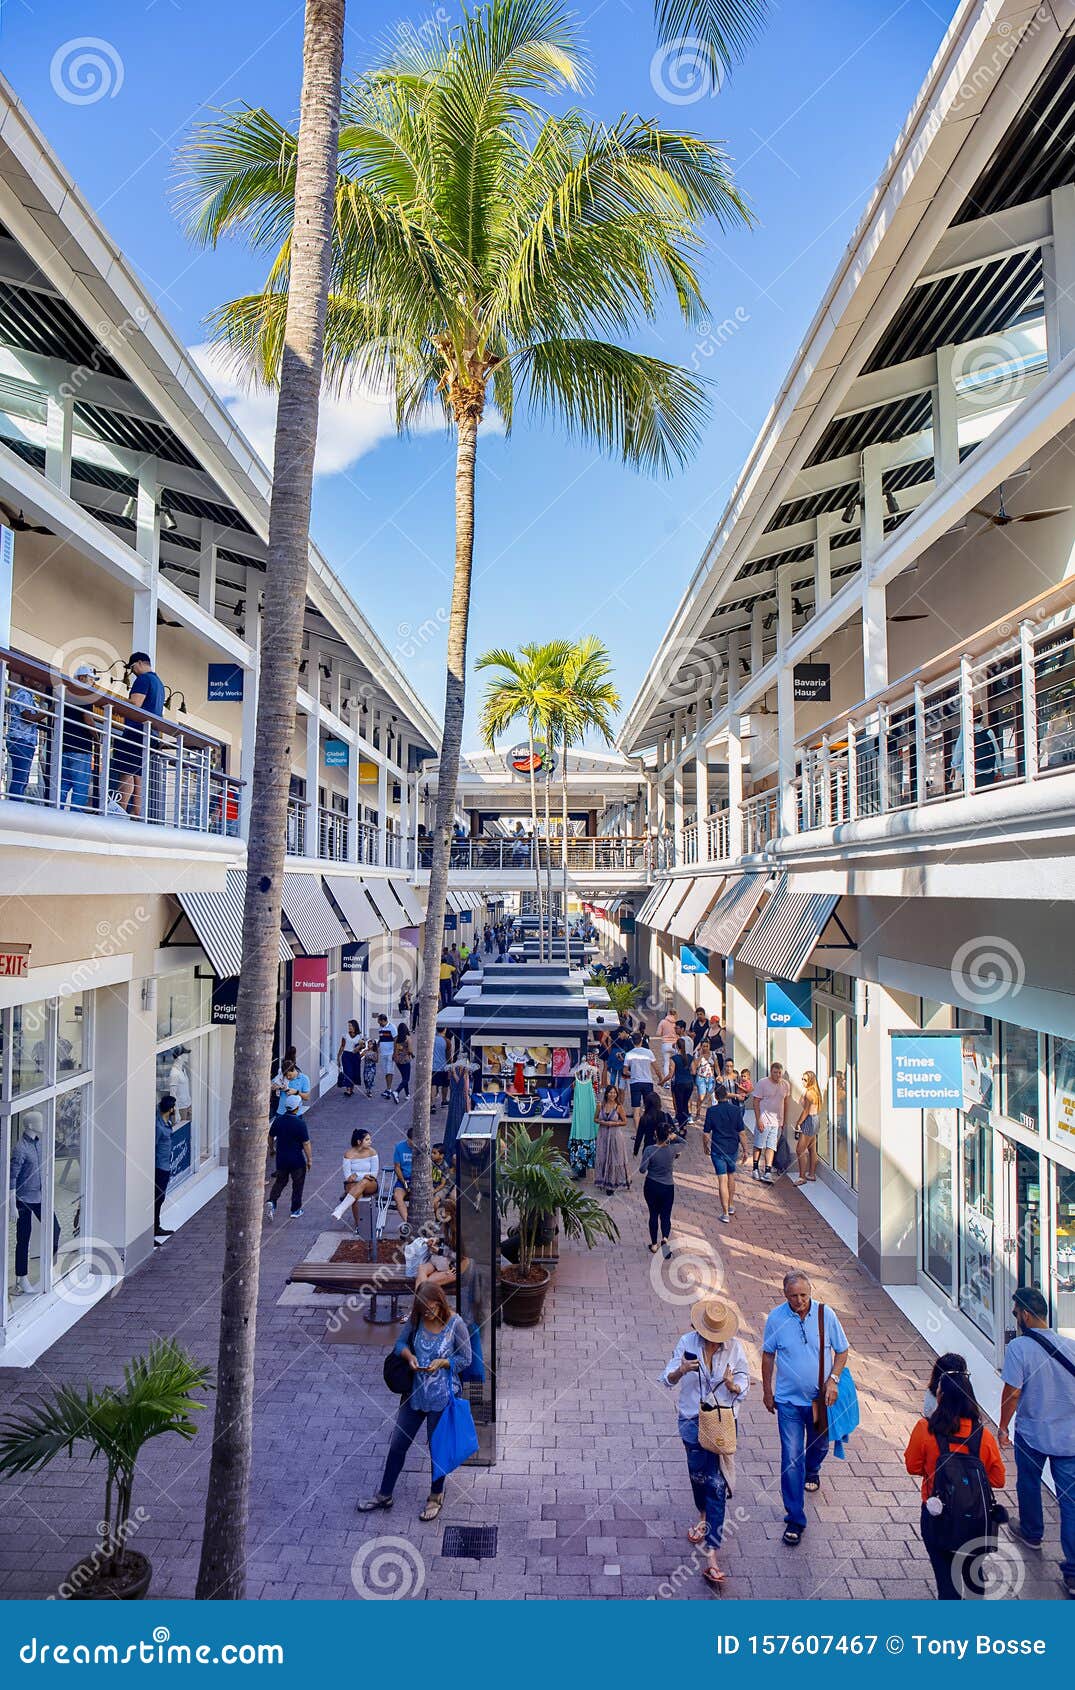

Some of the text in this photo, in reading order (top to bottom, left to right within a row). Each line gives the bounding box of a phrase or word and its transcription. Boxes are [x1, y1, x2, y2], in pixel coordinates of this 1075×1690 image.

[0, 955, 24, 975] EXIT
[303, 980, 325, 988] Nature
[213, 1012, 237, 1021] Peng
[770, 1012, 791, 1024] Gap
[896, 1056, 935, 1068] Times
[896, 1071, 942, 1085] Square
[896, 1087, 961, 1099] Electronics
